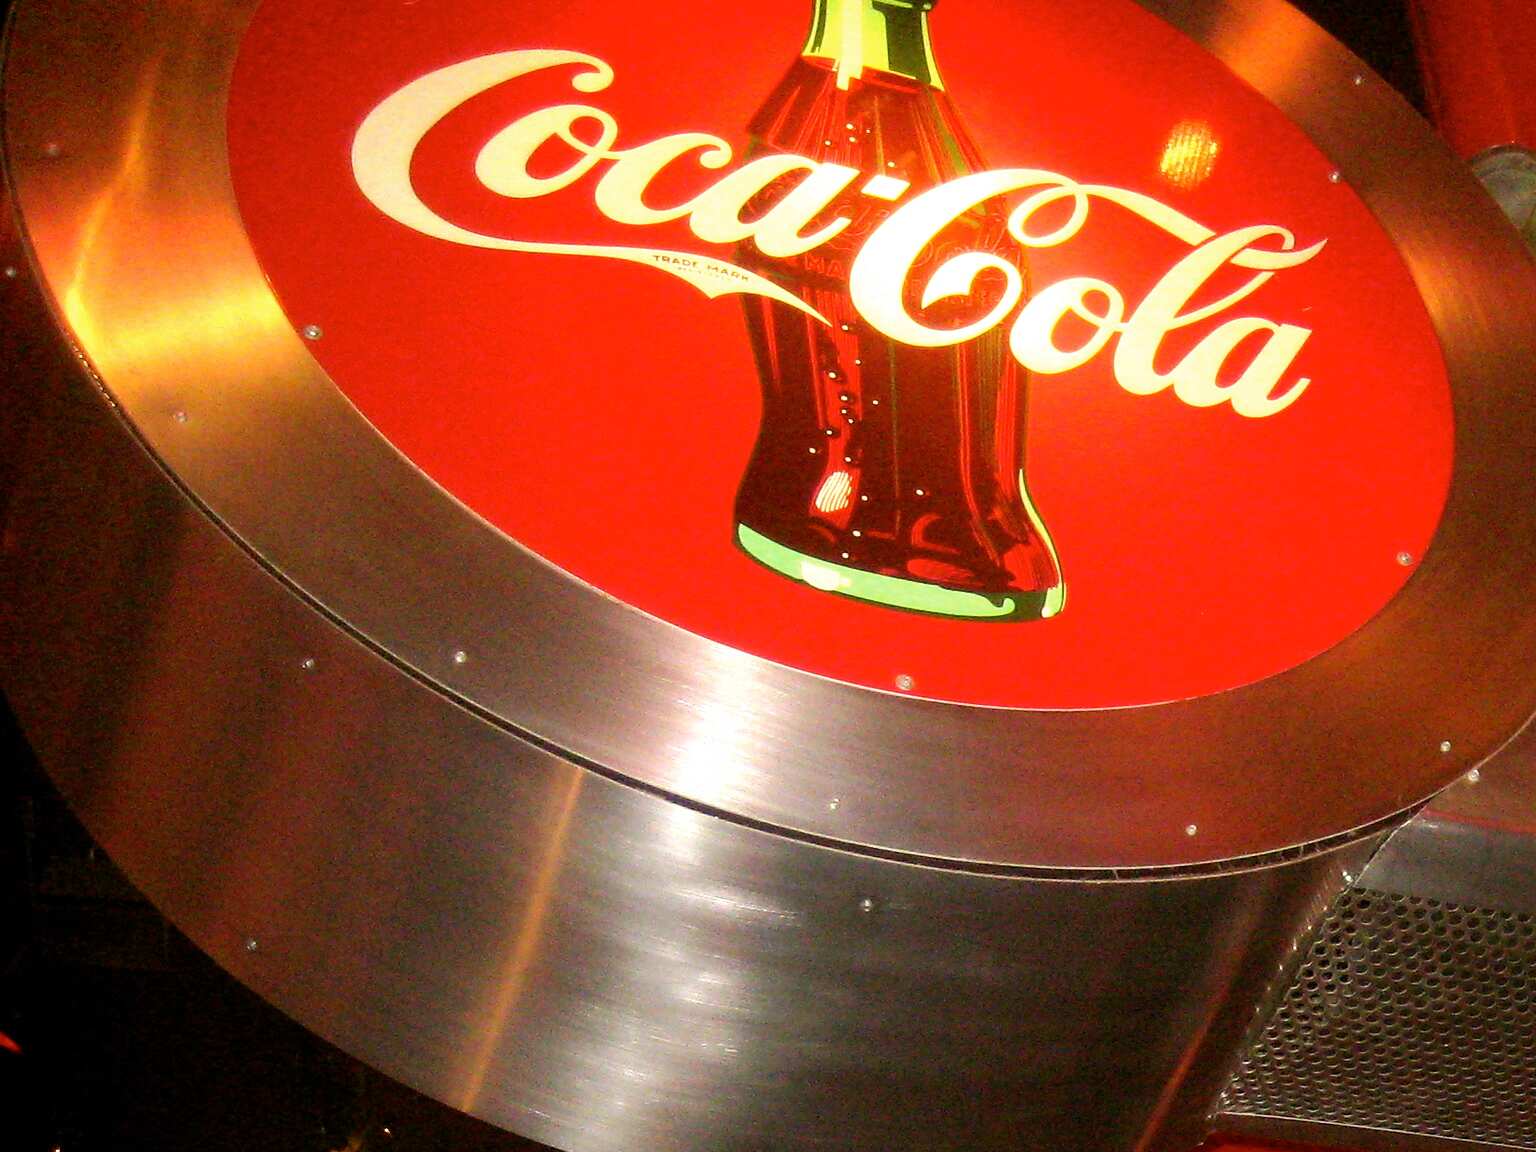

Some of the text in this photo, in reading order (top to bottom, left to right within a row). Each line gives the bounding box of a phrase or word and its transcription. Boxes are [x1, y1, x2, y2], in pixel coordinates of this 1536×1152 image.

[351, 49, 1328, 418] Coca-Cola
[653, 255, 698, 268] TRADE
[706, 264, 749, 281] MARK
